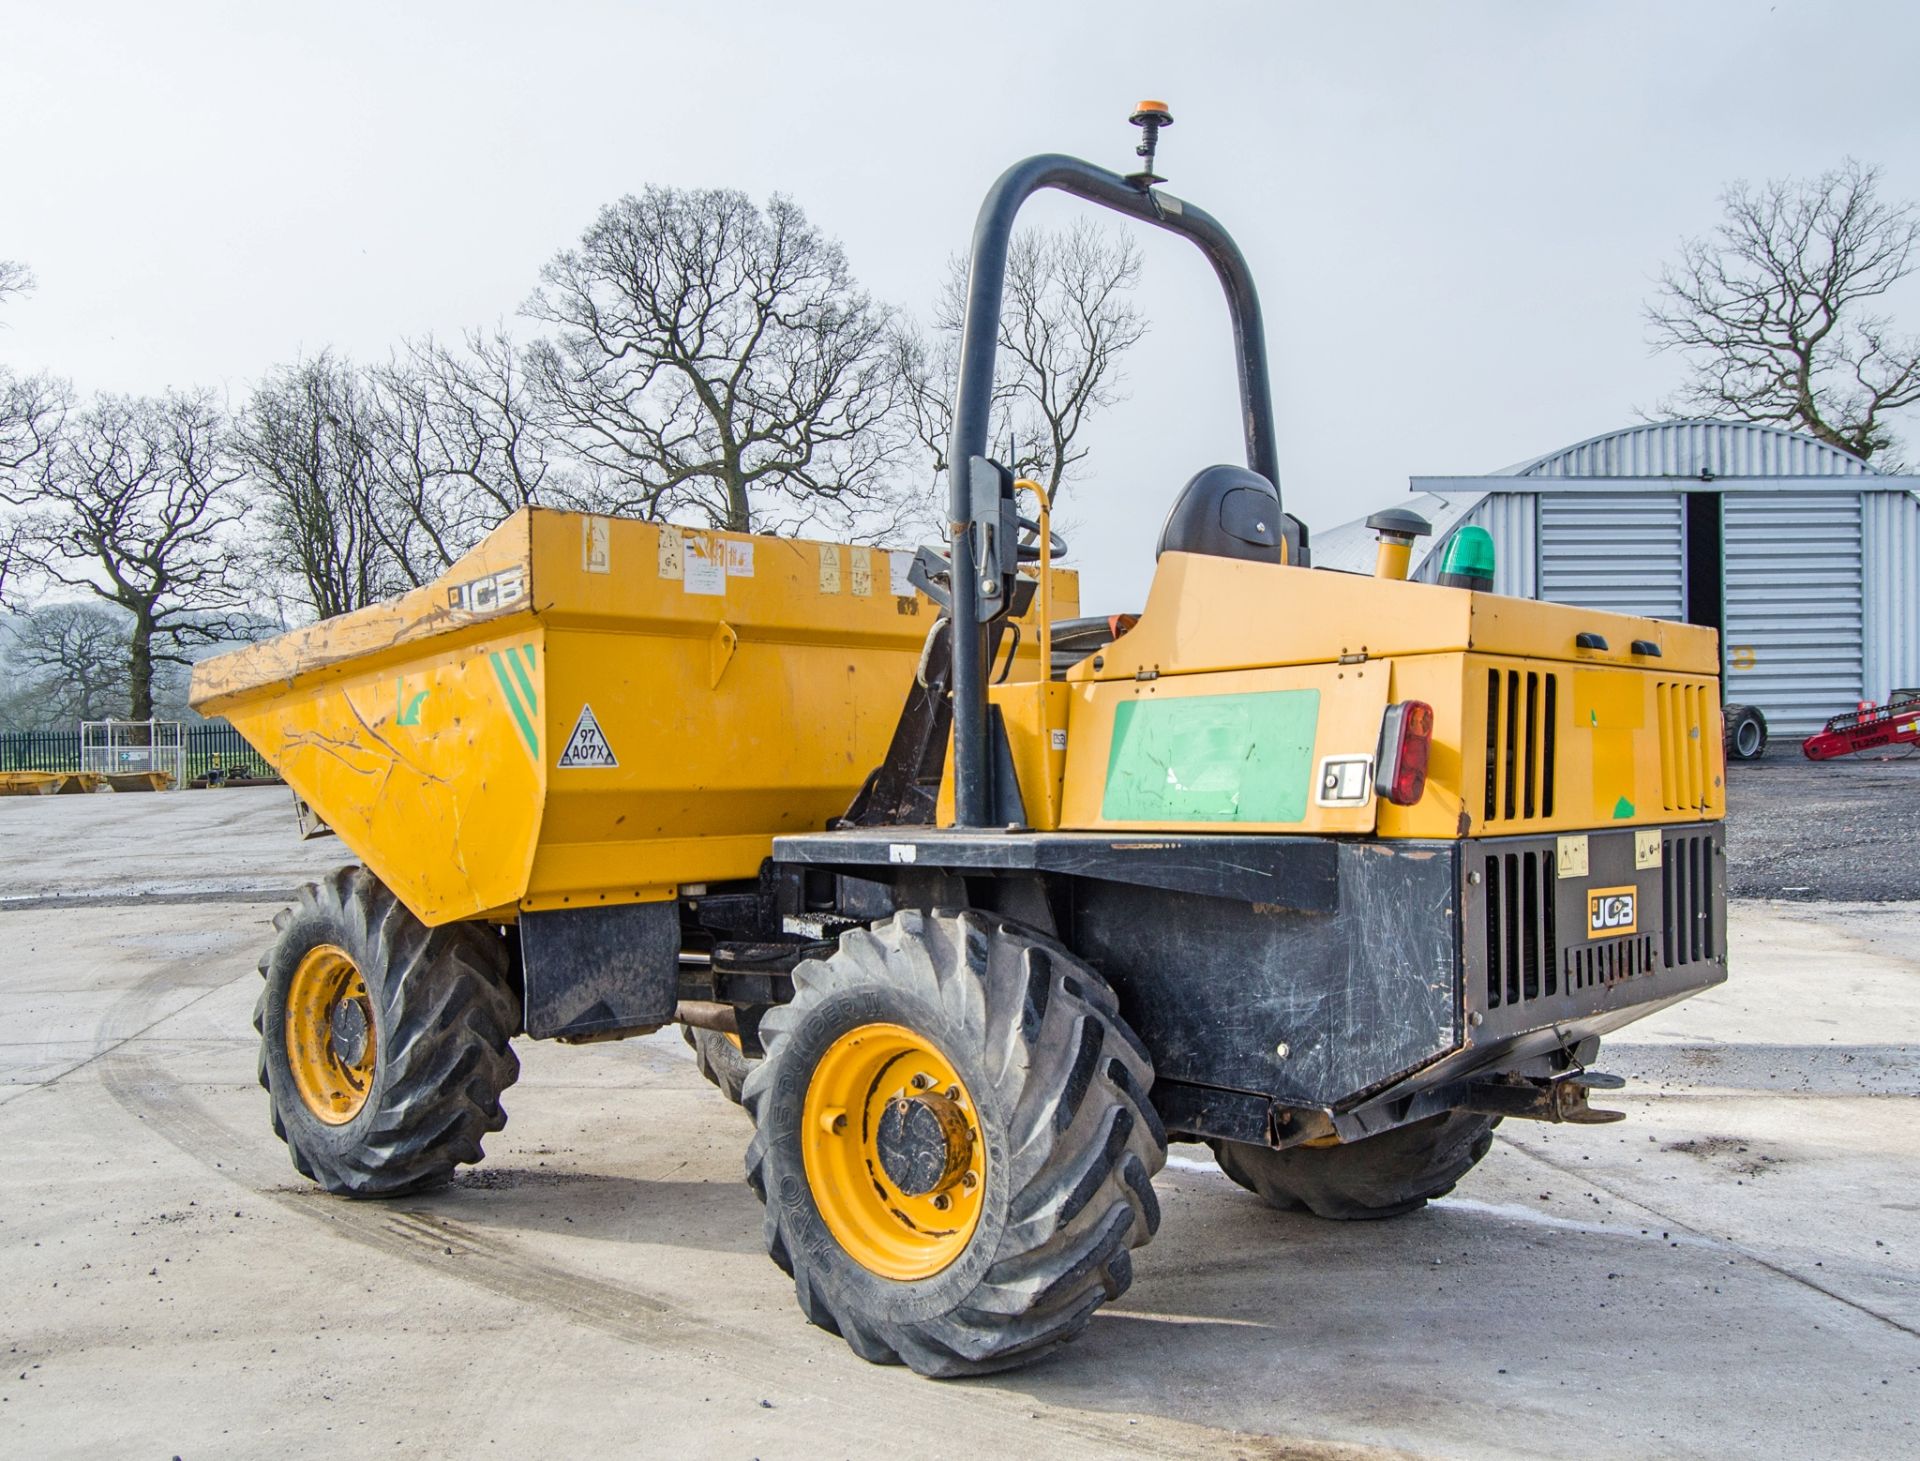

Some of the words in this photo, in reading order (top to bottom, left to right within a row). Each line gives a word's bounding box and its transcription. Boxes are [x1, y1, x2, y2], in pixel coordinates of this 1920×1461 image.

[449, 569, 524, 614] JCB
[1732, 645, 1757, 671] 8
[580, 729, 596, 744] 97
[1592, 896, 1633, 928] JCB
